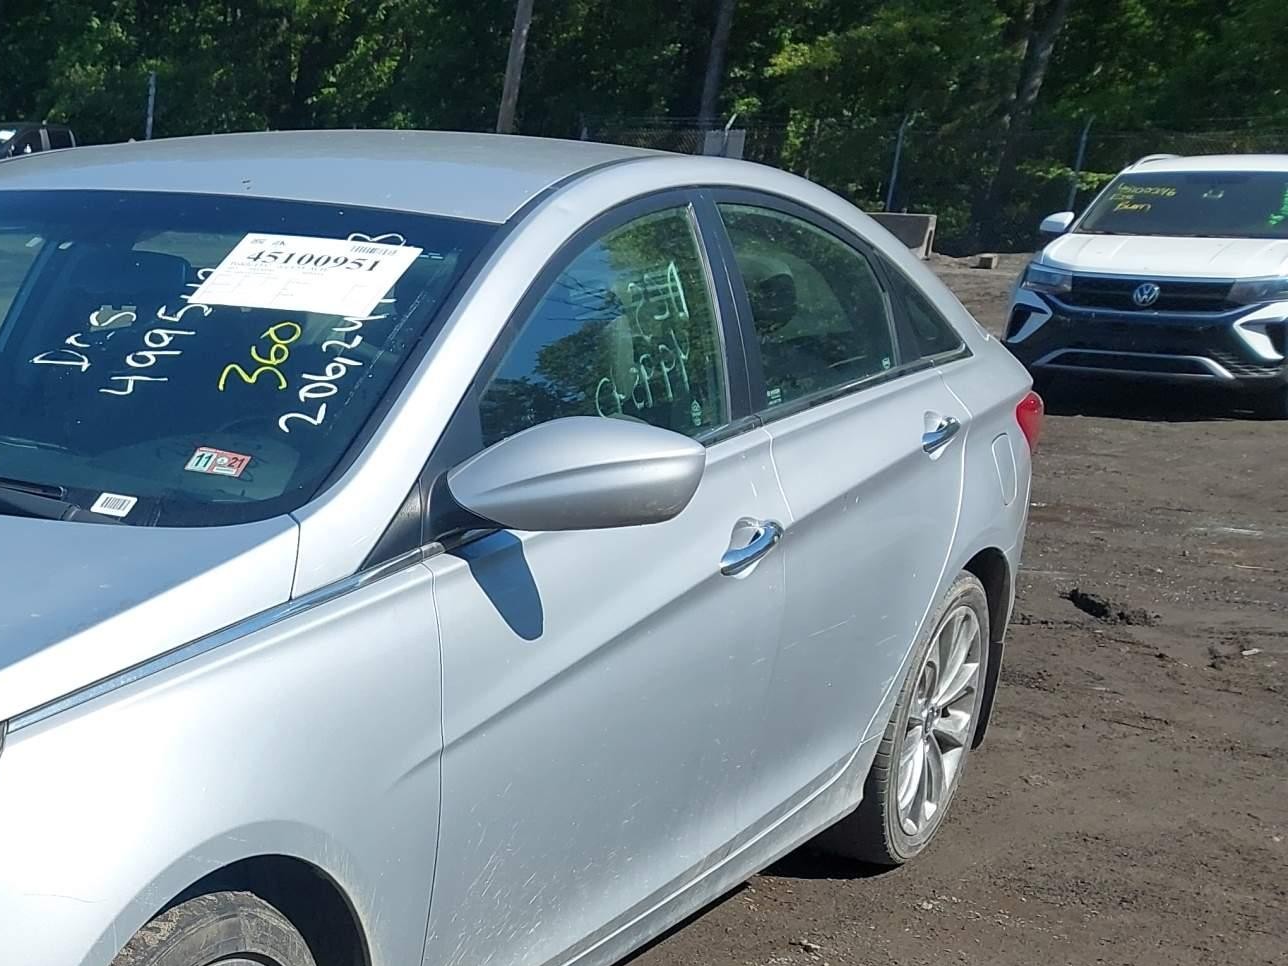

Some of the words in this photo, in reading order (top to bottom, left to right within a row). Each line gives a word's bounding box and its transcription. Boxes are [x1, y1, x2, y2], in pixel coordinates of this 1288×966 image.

[246, 249, 381, 272] 45100951
[99, 267, 216, 395] 4995
[219, 322, 302, 391] 360
[195, 452, 213, 468] 11
[227, 456, 245, 468] 21
